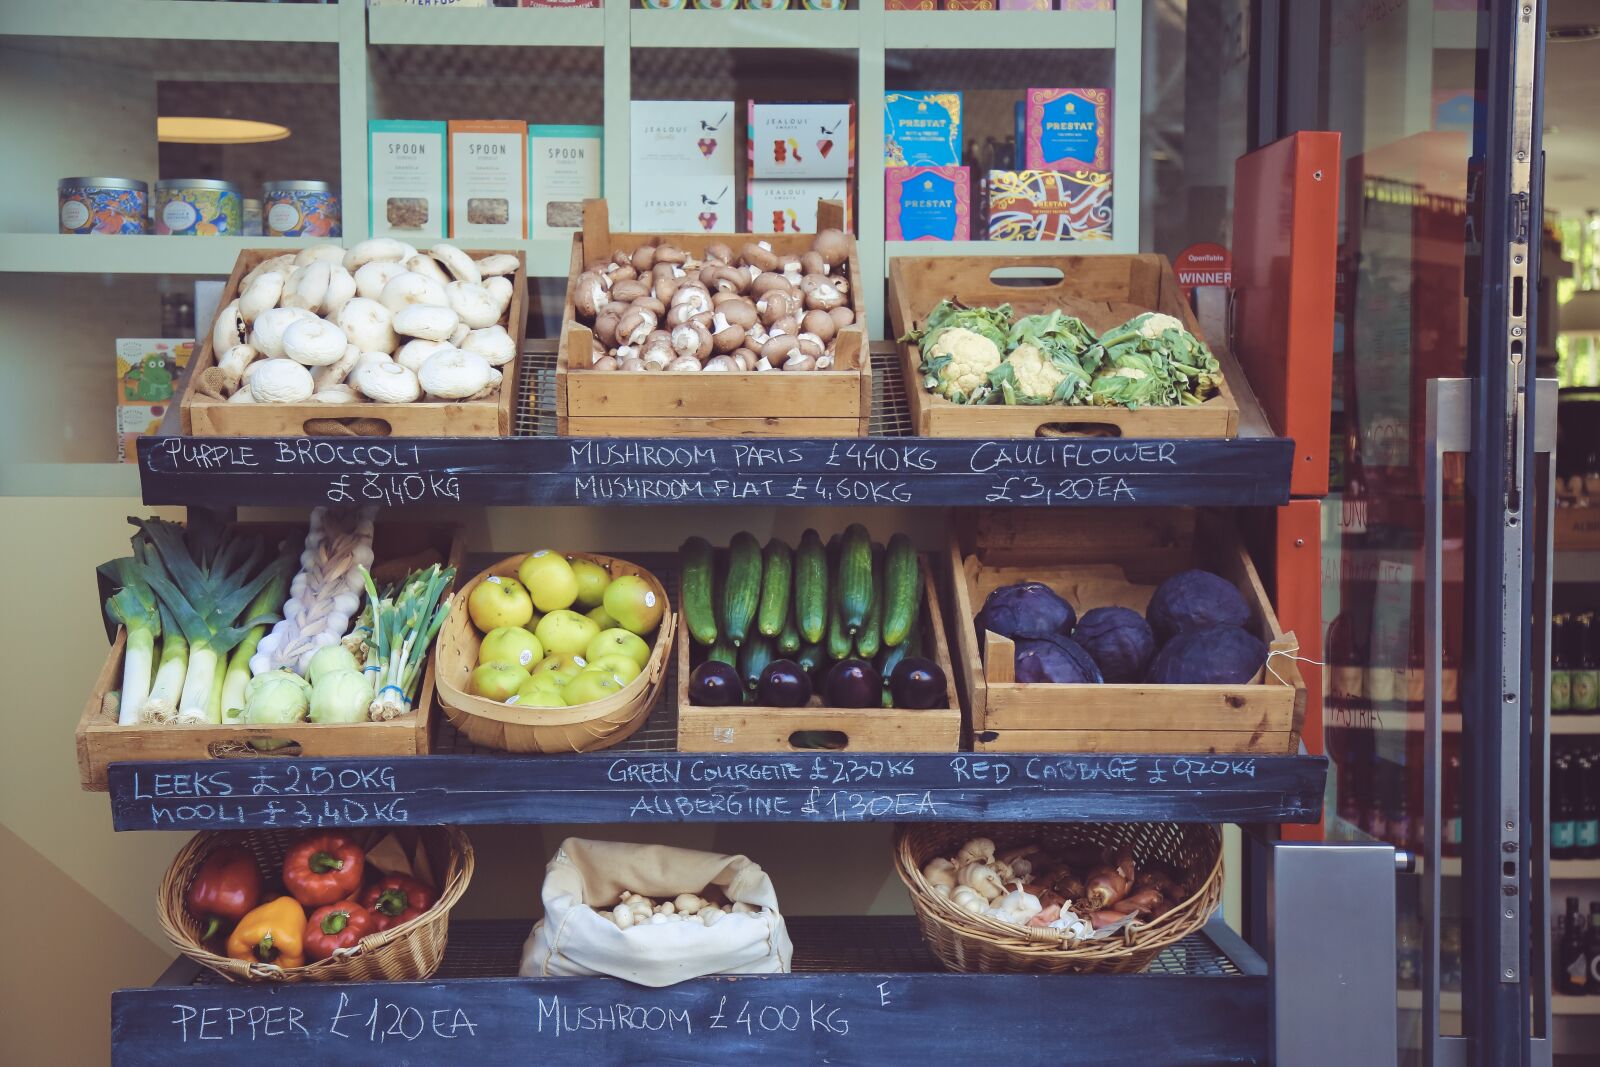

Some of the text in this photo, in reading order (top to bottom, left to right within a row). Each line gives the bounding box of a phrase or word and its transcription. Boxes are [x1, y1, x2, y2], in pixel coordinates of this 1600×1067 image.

[899, 119, 947, 128] PRESTAT
[1045, 121, 1095, 131] PRESTAT
[388, 143, 426, 155] SPOON
[469, 143, 507, 155] SPOON
[548, 147, 585, 159] SPOON
[904, 199, 953, 208] PRESTAT
[1188, 254, 1225, 262] OpenTable
[1179, 272, 1232, 284] WINNER
[163, 438, 420, 468] PURPLE BROCCOLI
[570, 441, 716, 468] MUSHROOM
[732, 443, 804, 468] PARIS
[970, 442, 1178, 472] CAULIFLOWER
[574, 475, 704, 499] MUSHROOM
[714, 479, 773, 499] FLAT
[608, 758, 681, 783] GREEN
[950, 756, 1010, 784] RED
[1026, 757, 1139, 782] CABBAGE
[134, 771, 233, 800] LEEKS
[629, 794, 791, 817] AUBERGINE
[876, 981, 891, 1007] E
[172, 1004, 310, 1042] PEPPER
[538, 995, 692, 1037] MUSHROOM
